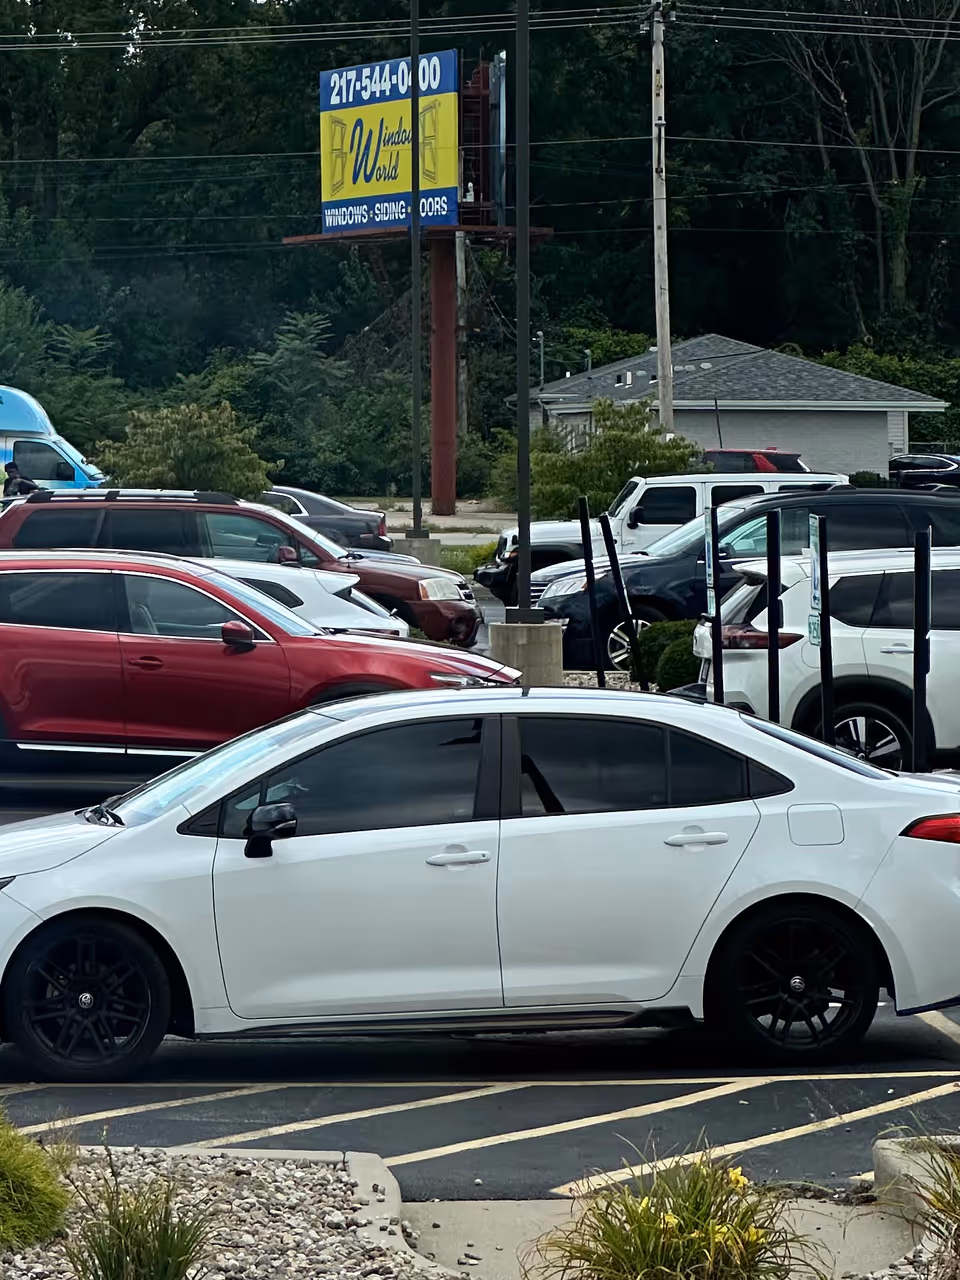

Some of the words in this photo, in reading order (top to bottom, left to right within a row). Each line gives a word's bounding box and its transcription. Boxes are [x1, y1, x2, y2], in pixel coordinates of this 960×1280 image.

[330, 56, 441, 105] 217-544-000
[324, 204, 368, 227] WINDOWS
[374, 200, 406, 222] SIDING
[419, 196, 448, 218] OORS
